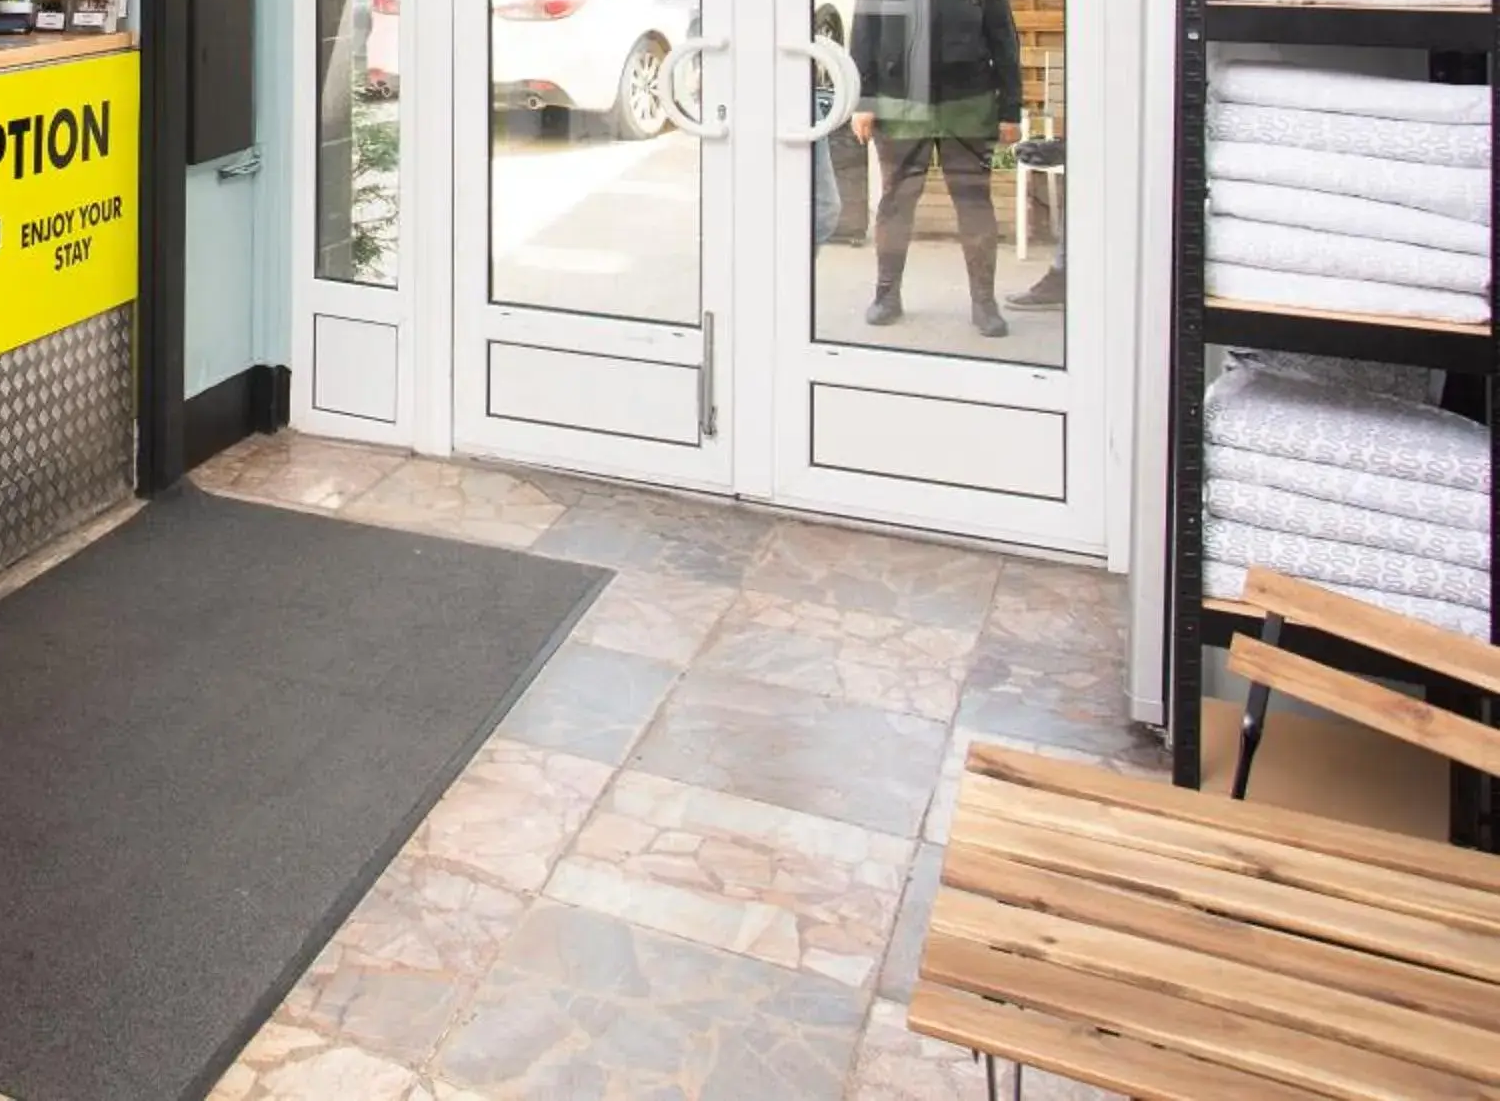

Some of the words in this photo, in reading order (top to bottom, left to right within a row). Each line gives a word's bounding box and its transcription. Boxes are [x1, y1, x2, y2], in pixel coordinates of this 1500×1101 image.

[21, 209, 74, 249] ENJOY
[81, 197, 122, 230] YOUR
[54, 236, 93, 271] STAY
